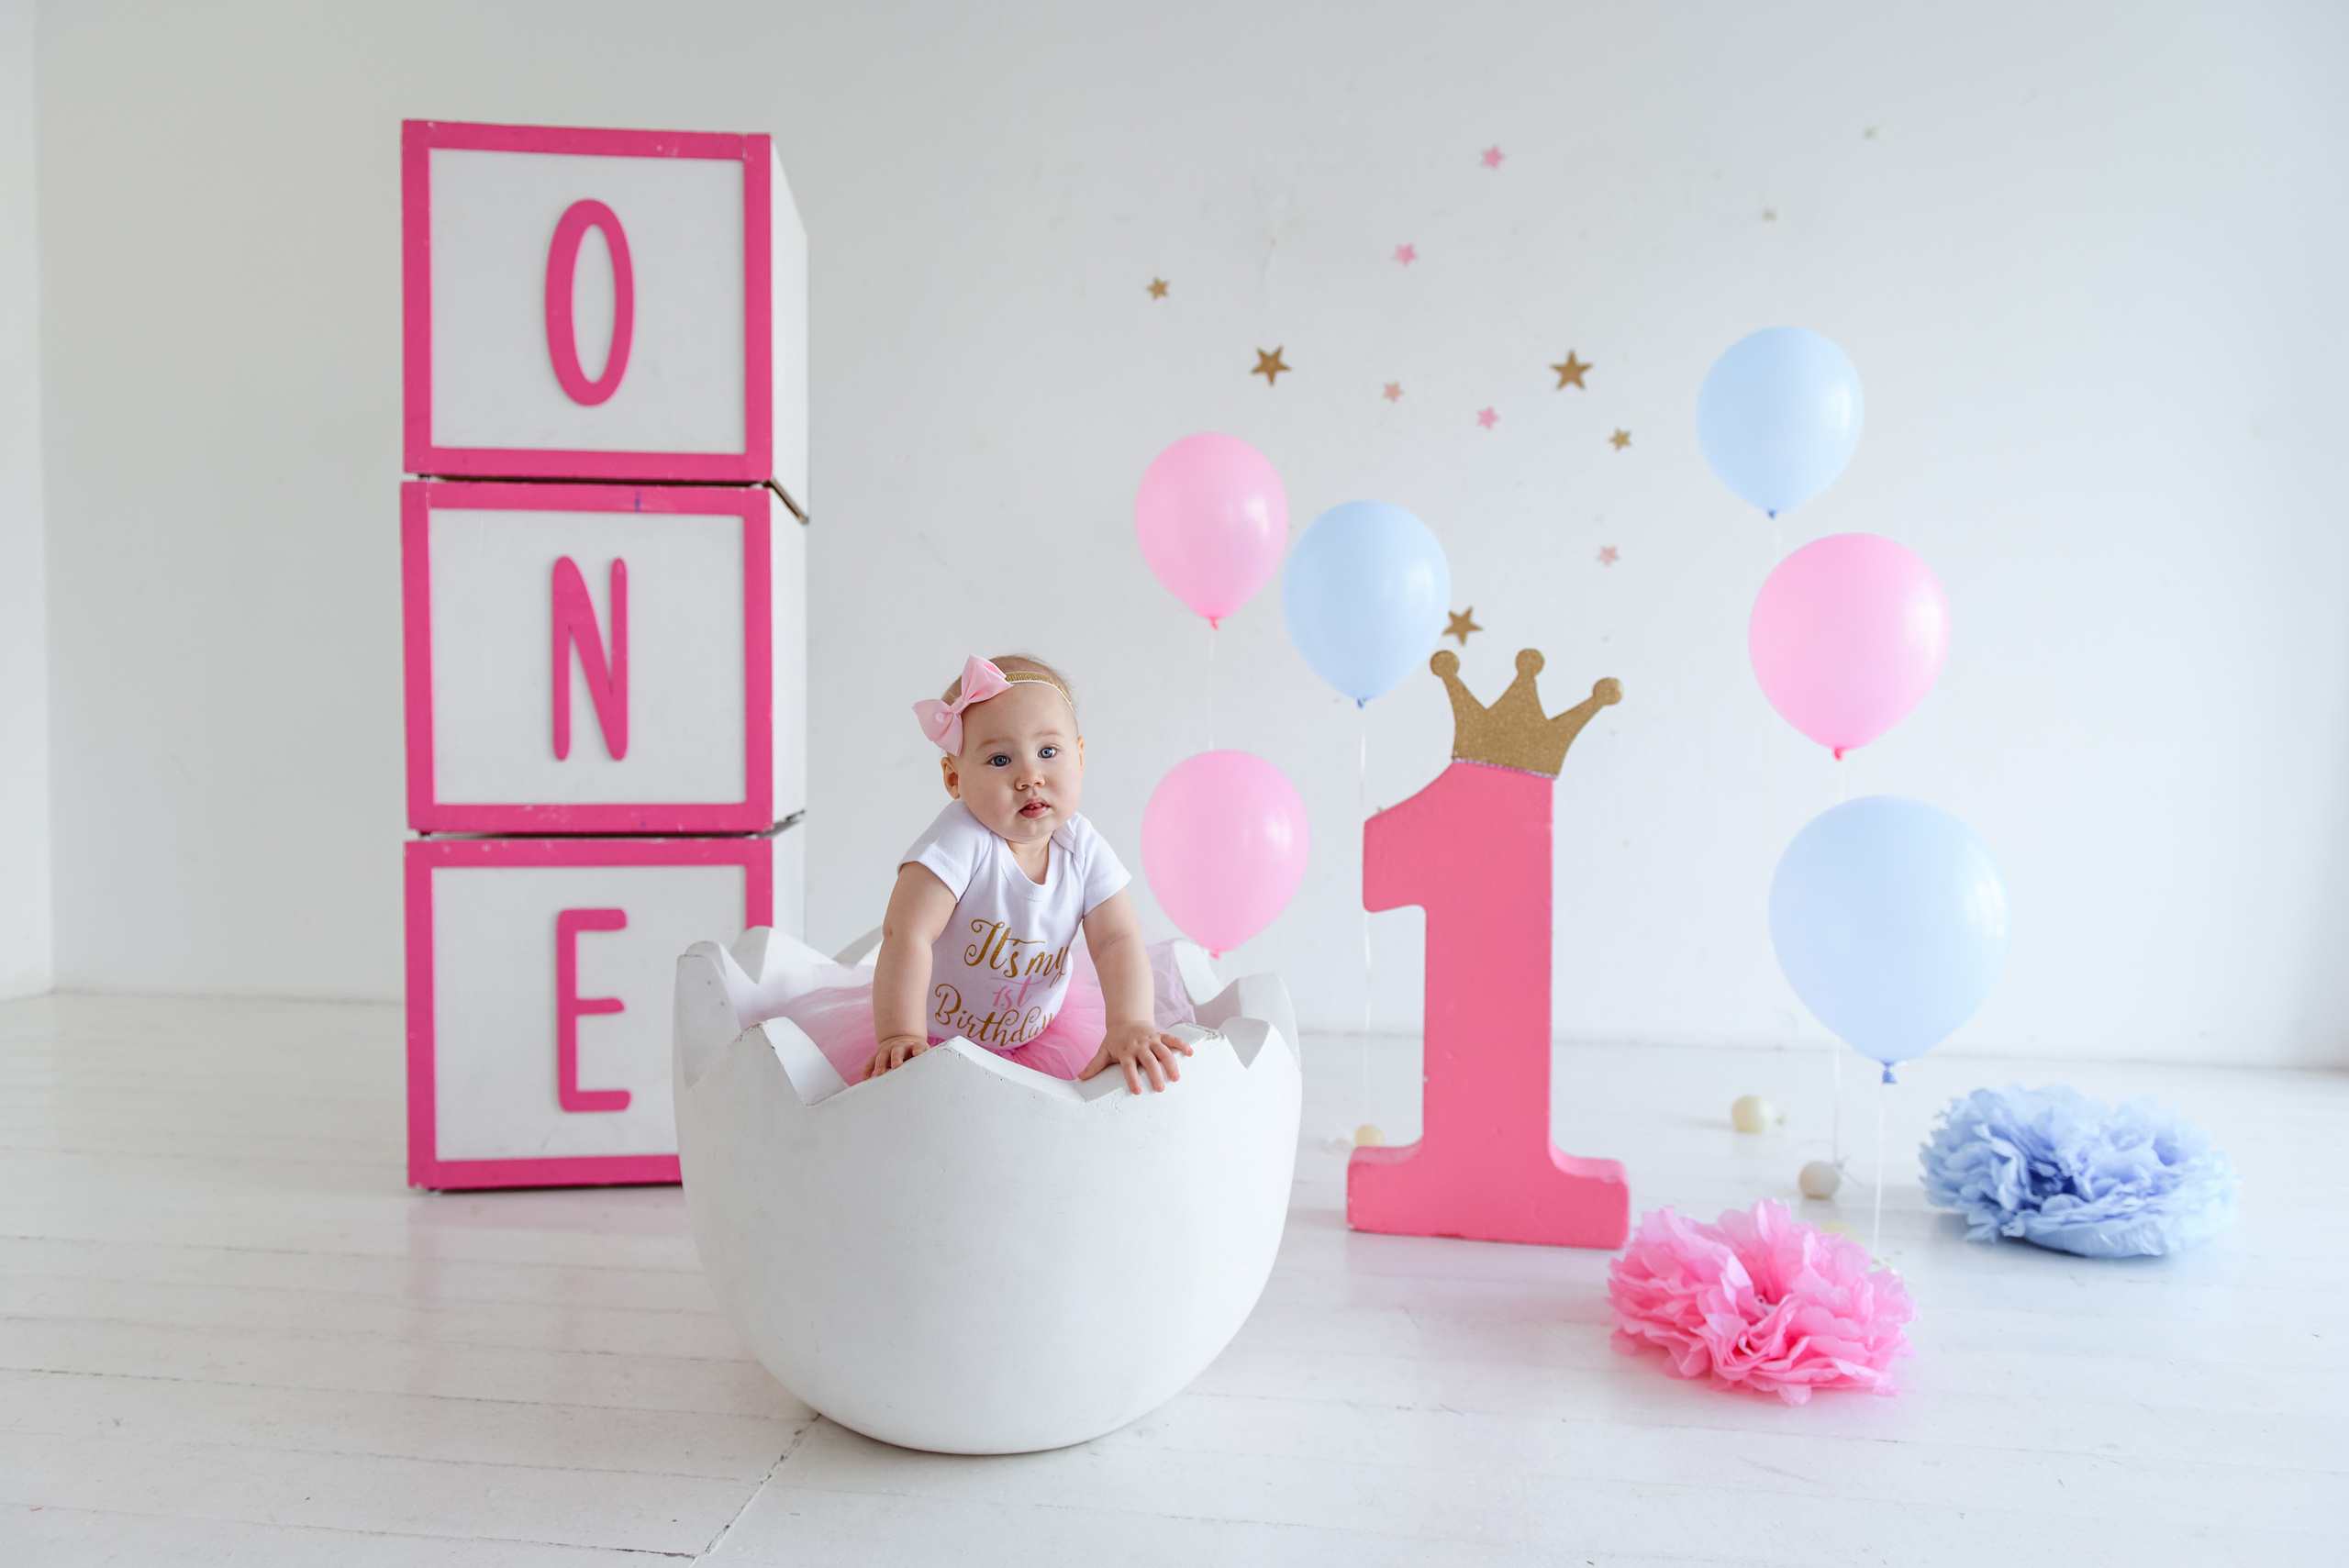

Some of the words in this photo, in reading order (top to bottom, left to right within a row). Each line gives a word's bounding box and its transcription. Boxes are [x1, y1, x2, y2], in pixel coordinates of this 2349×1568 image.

[963, 918, 1046, 978] It's
[1024, 946, 1069, 988] my
[989, 974, 1044, 1010] 1st
[1347, 761, 1630, 1249] 1
